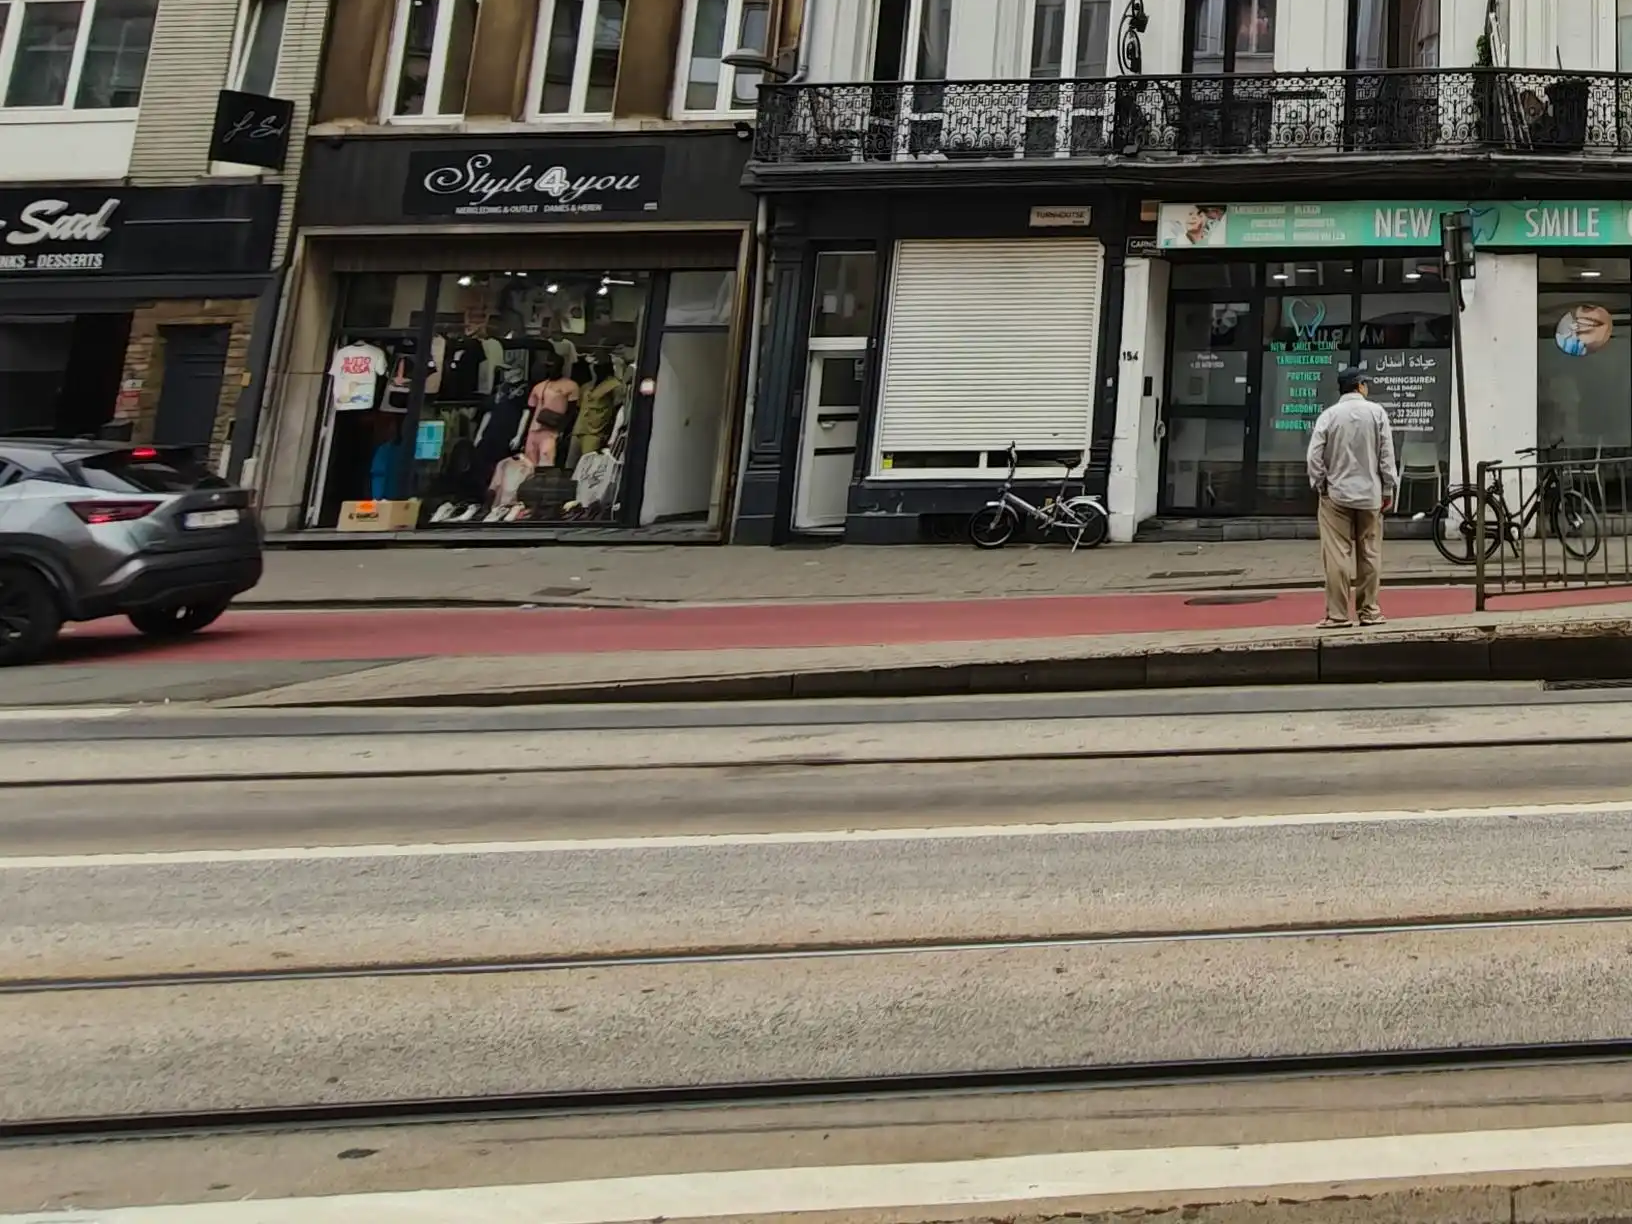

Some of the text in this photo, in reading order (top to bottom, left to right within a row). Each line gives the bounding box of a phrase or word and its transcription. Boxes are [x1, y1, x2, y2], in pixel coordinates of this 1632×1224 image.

[424, 154, 640, 205] Style4you
[1374, 208, 1432, 238] NEW
[1524, 207, 1600, 238] SMILE
[37, 253, 104, 268] DESSERTS
[1373, 376, 1435, 384] OPENINGSUREN
